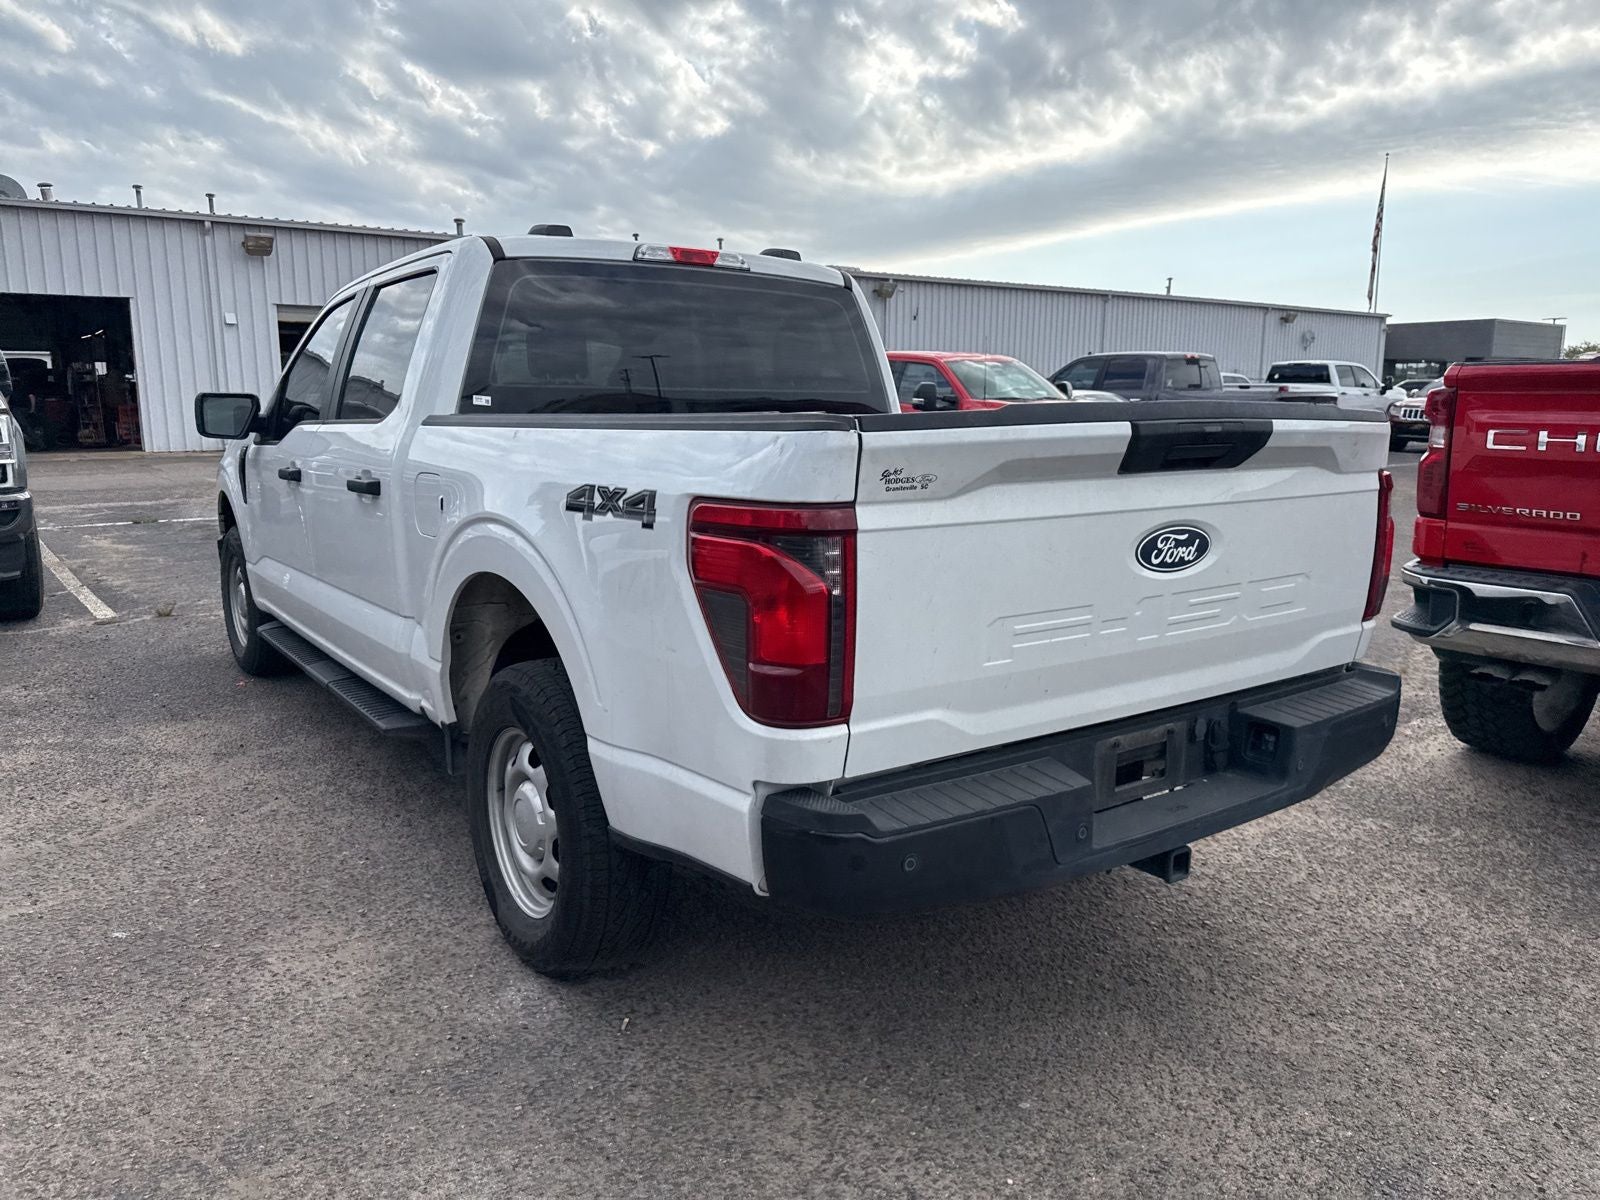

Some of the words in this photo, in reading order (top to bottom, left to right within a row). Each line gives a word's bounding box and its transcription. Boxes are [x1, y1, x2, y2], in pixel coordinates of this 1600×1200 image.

[1486, 429, 1600, 452] CH
[884, 476, 915, 485] HODGES
[1456, 502, 1581, 521] SILVERADO
[1151, 533, 1199, 565] Ford
[983, 572, 1311, 666] F-150
